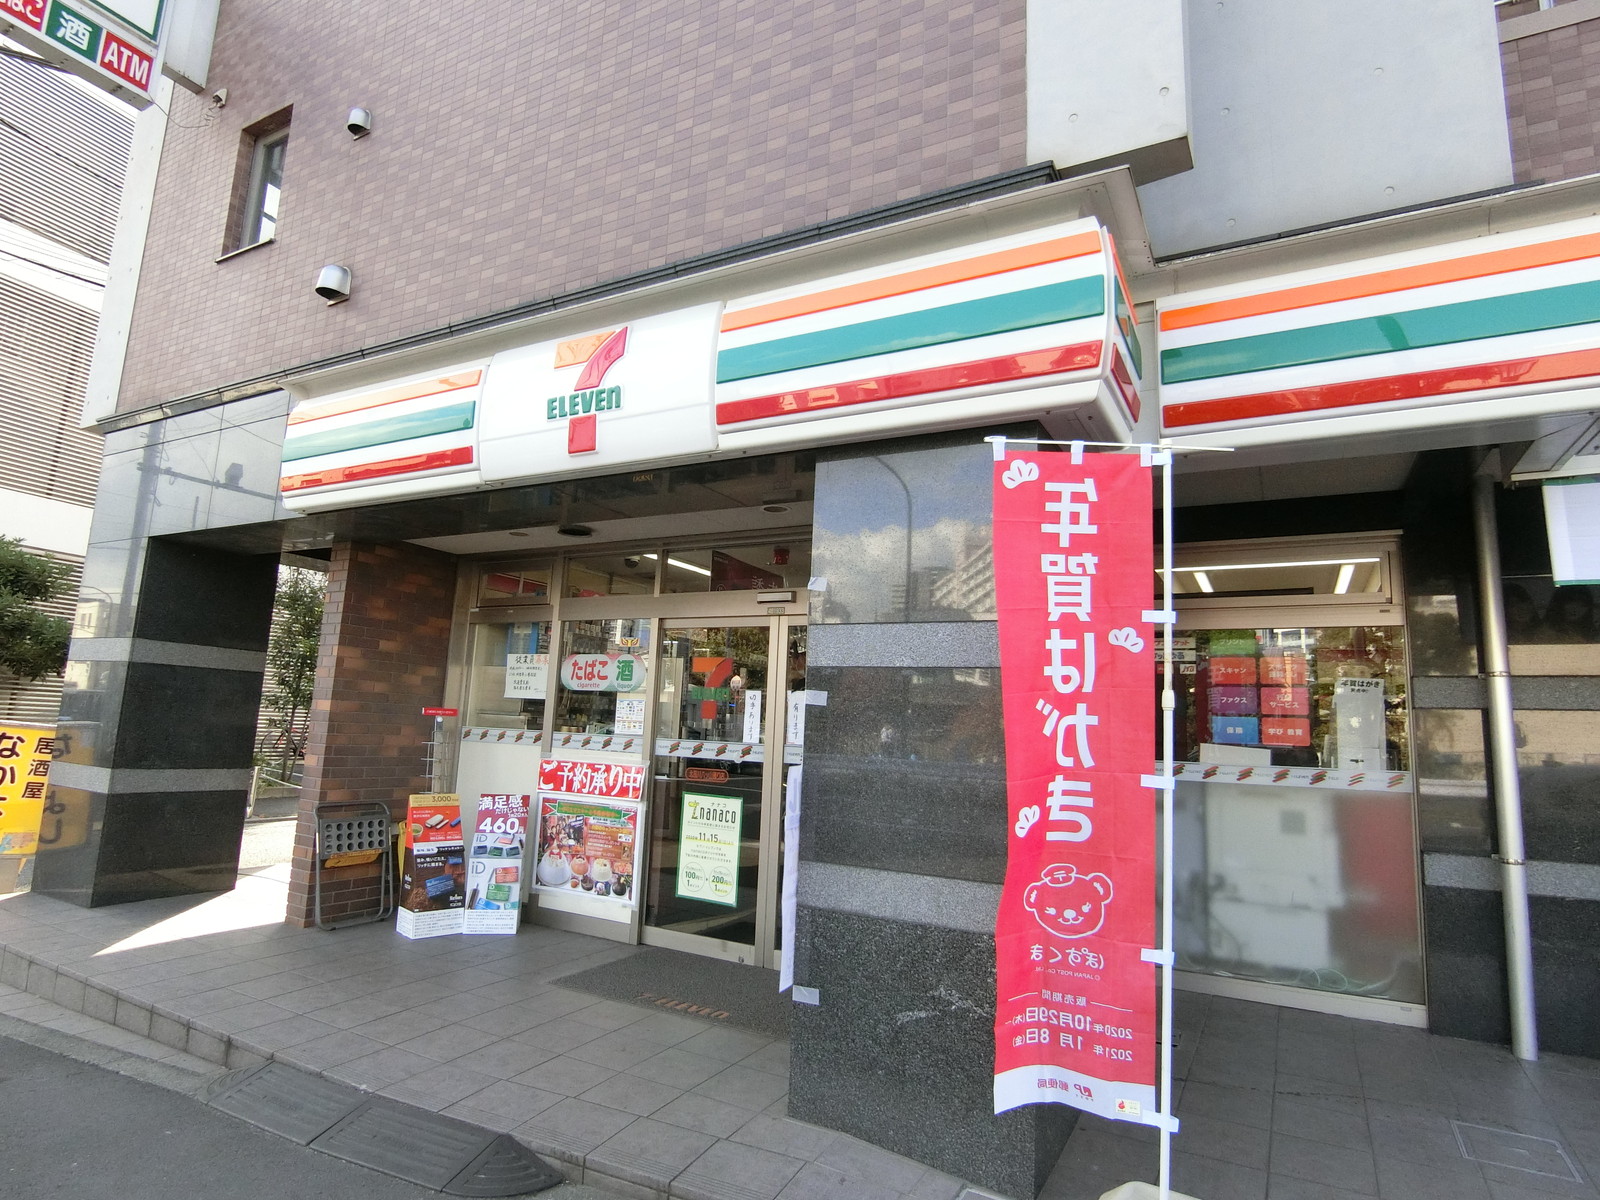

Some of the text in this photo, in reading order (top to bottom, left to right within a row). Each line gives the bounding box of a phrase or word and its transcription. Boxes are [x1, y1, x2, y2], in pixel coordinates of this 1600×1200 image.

[56, 10, 93, 51] 酒
[103, 41, 150, 85] ATM
[571, 659, 608, 681] たばこ
[616, 660, 634, 681] 酒
[21, 737, 54, 799] 居酒屋
[540, 760, 641, 798] ご予約承り中
[478, 795, 523, 810] 満足感
[495, 807, 530, 815] だけじゃない
[700, 807, 736, 824] nanaco
